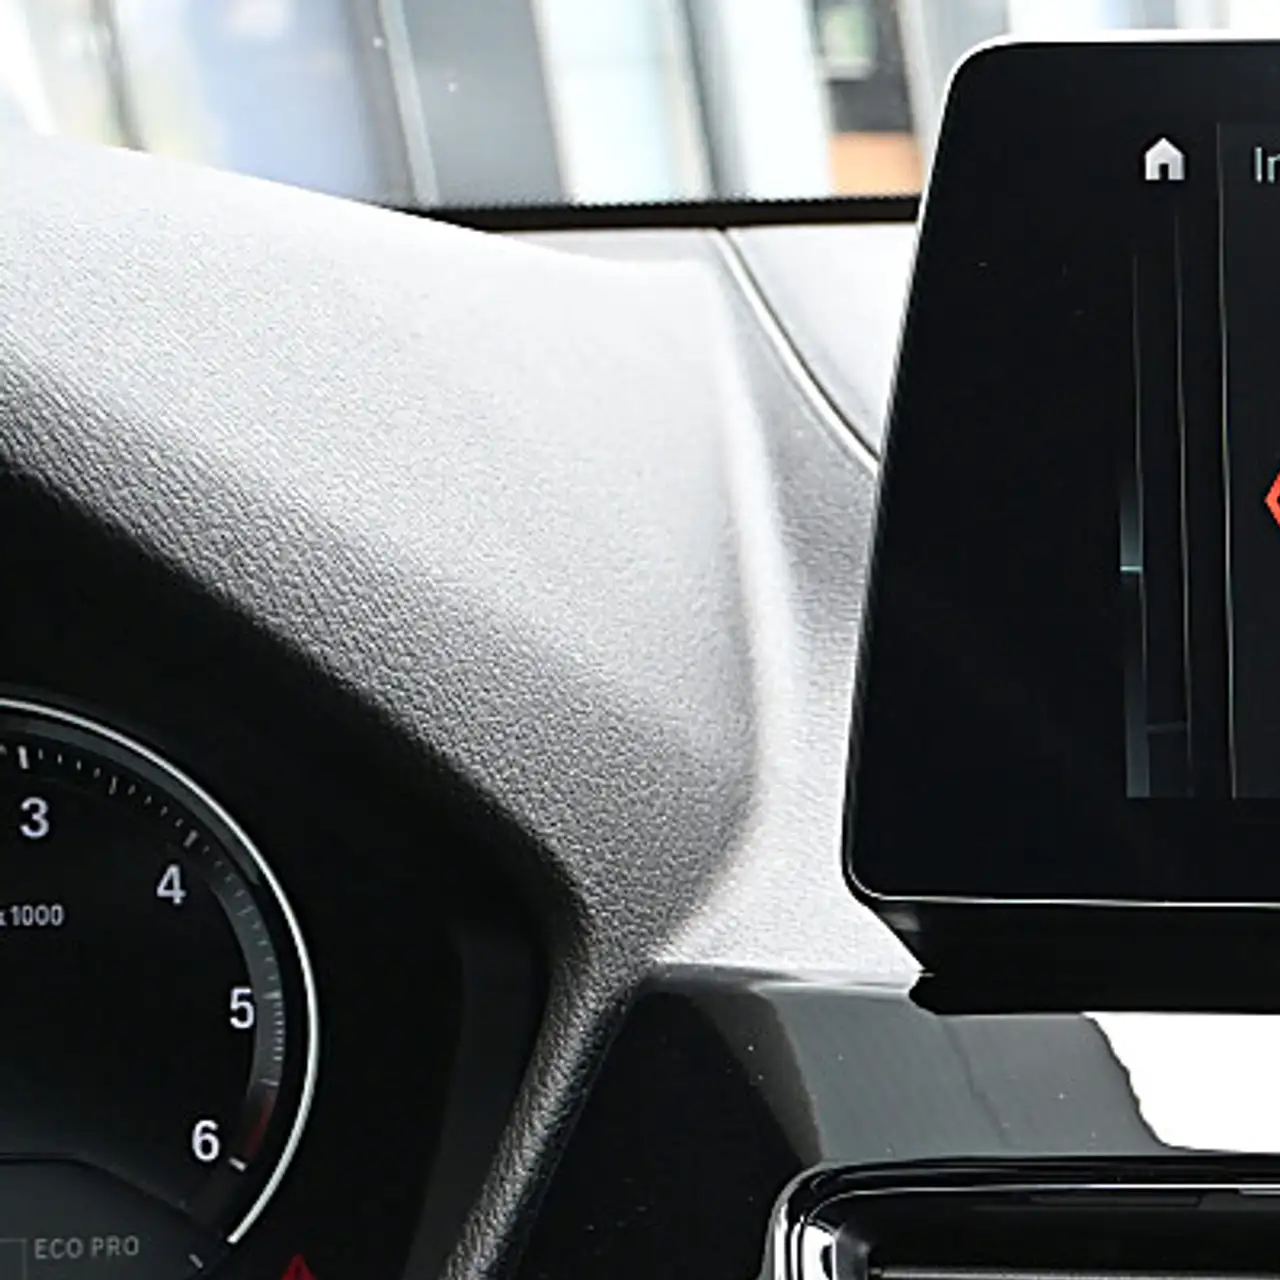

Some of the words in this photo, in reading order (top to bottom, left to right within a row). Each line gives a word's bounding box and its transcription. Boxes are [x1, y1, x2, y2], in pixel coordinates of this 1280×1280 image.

[21, 798, 48, 837] 3
[157, 865, 185, 904] 4
[231, 988, 253, 1028] 5
[193, 1120, 218, 1160] 6
[35, 1238, 83, 1259] ECO
[92, 1236, 138, 1256] PRO
